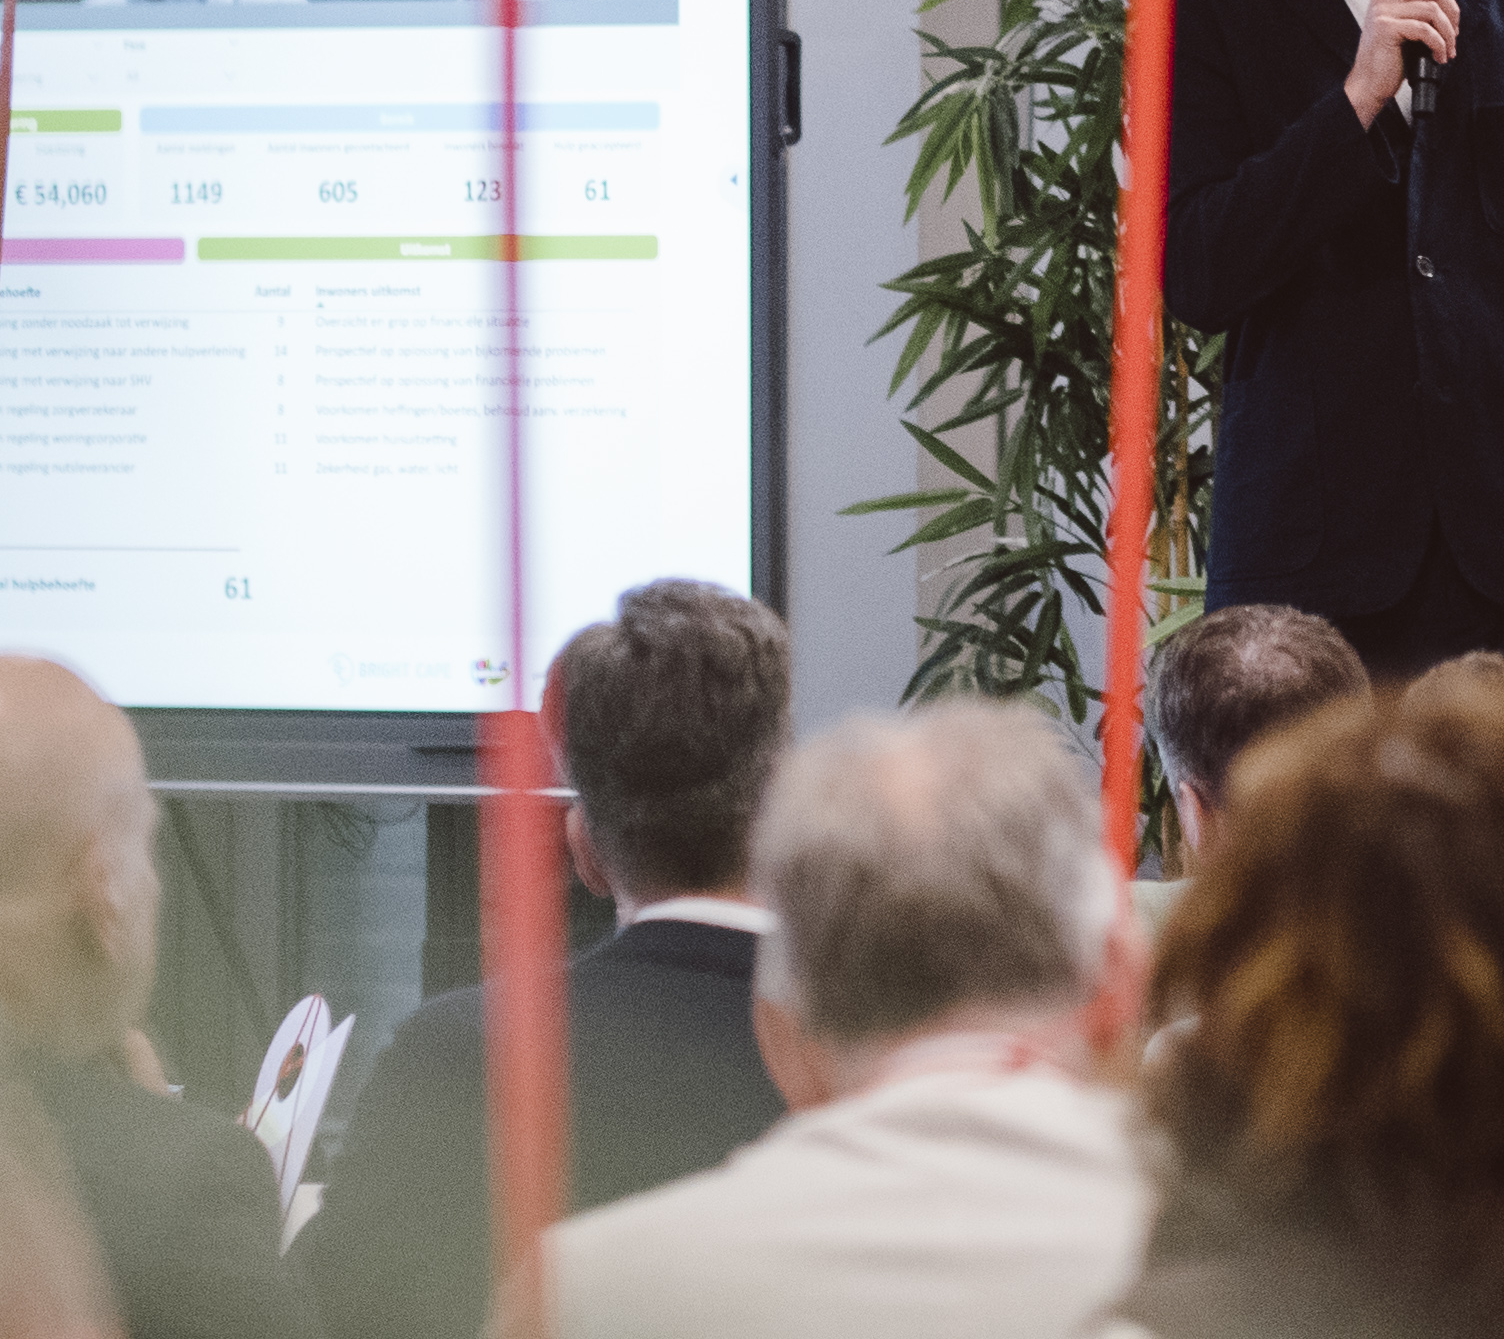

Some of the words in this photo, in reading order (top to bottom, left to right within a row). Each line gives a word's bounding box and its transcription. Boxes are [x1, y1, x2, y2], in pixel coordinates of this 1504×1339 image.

[170, 180, 224, 204] 1149
[318, 179, 359, 203] 605
[463, 179, 502, 202] 123
[584, 179, 612, 202] 61
[225, 577, 253, 600] 61
